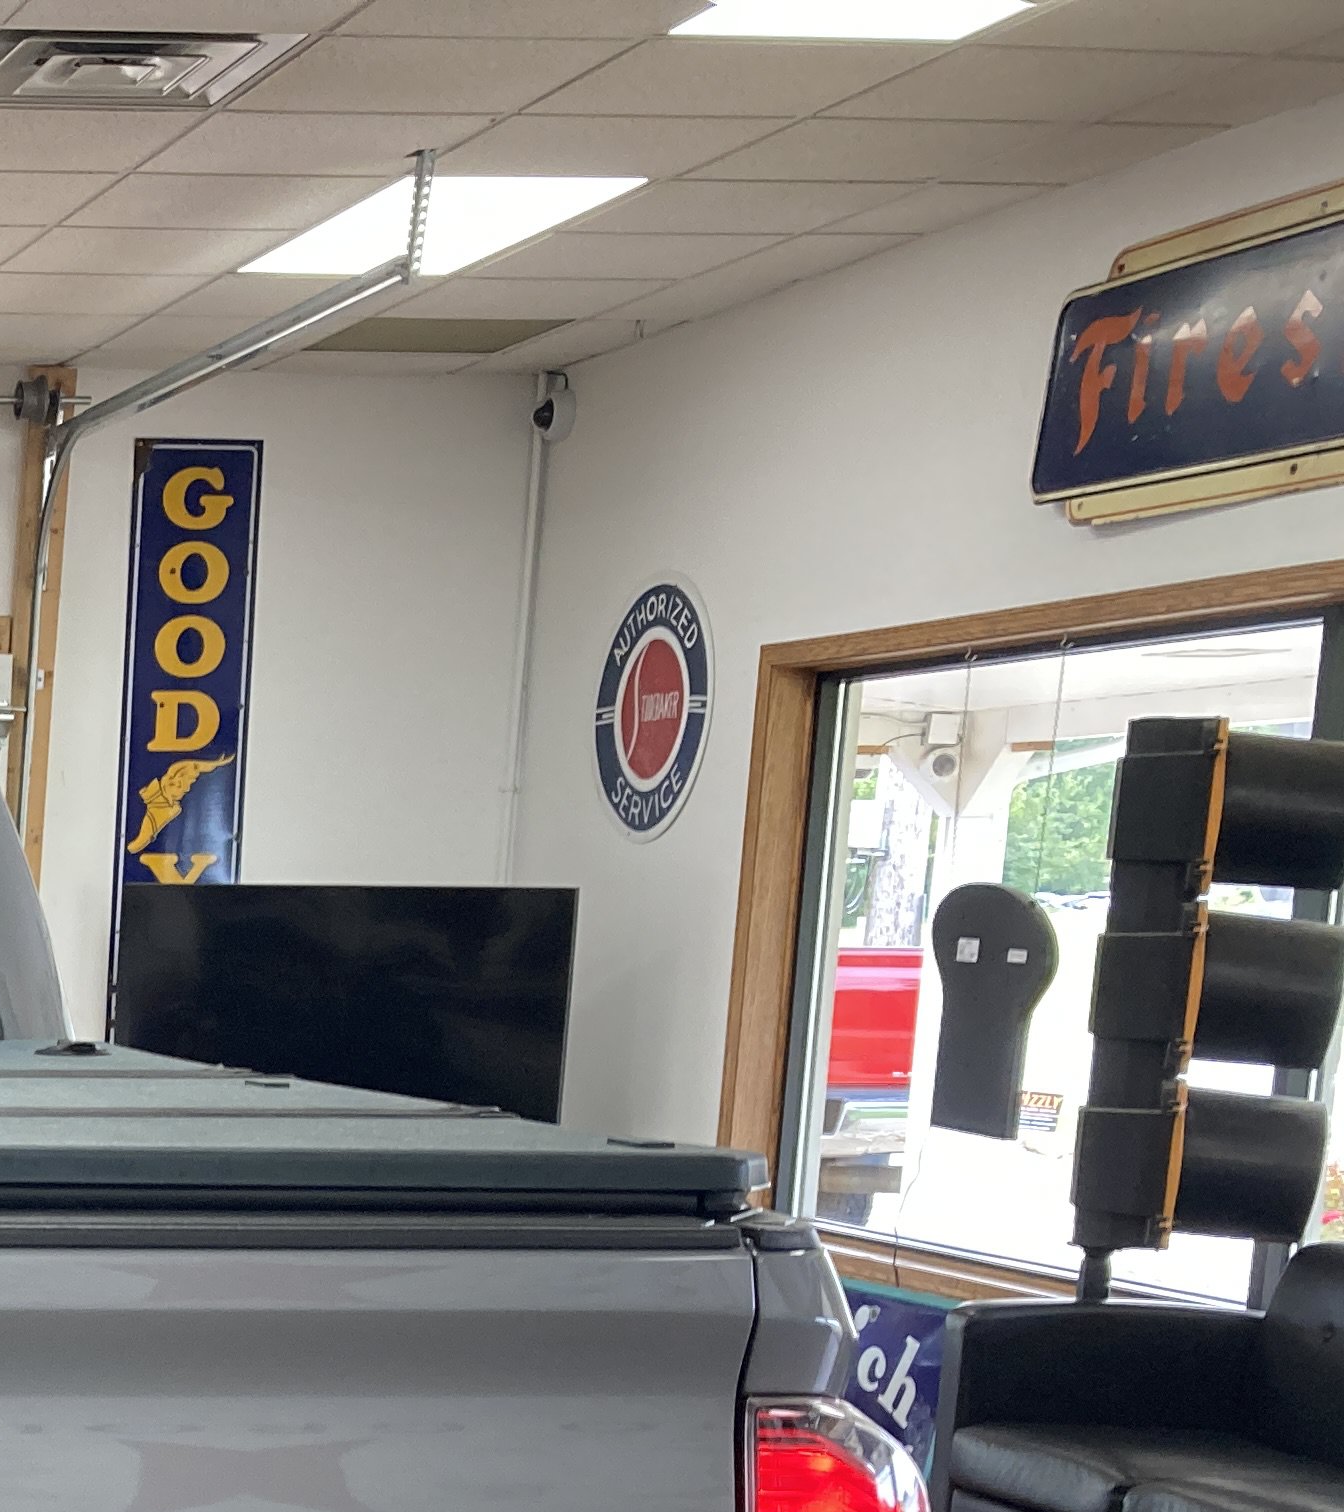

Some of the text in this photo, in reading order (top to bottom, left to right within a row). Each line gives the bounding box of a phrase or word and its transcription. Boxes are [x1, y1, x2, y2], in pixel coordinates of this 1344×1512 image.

[146, 466, 234, 753] GOOD
[613, 593, 699, 667] AUTHORIZED
[612, 762, 683, 826] SERVICE
